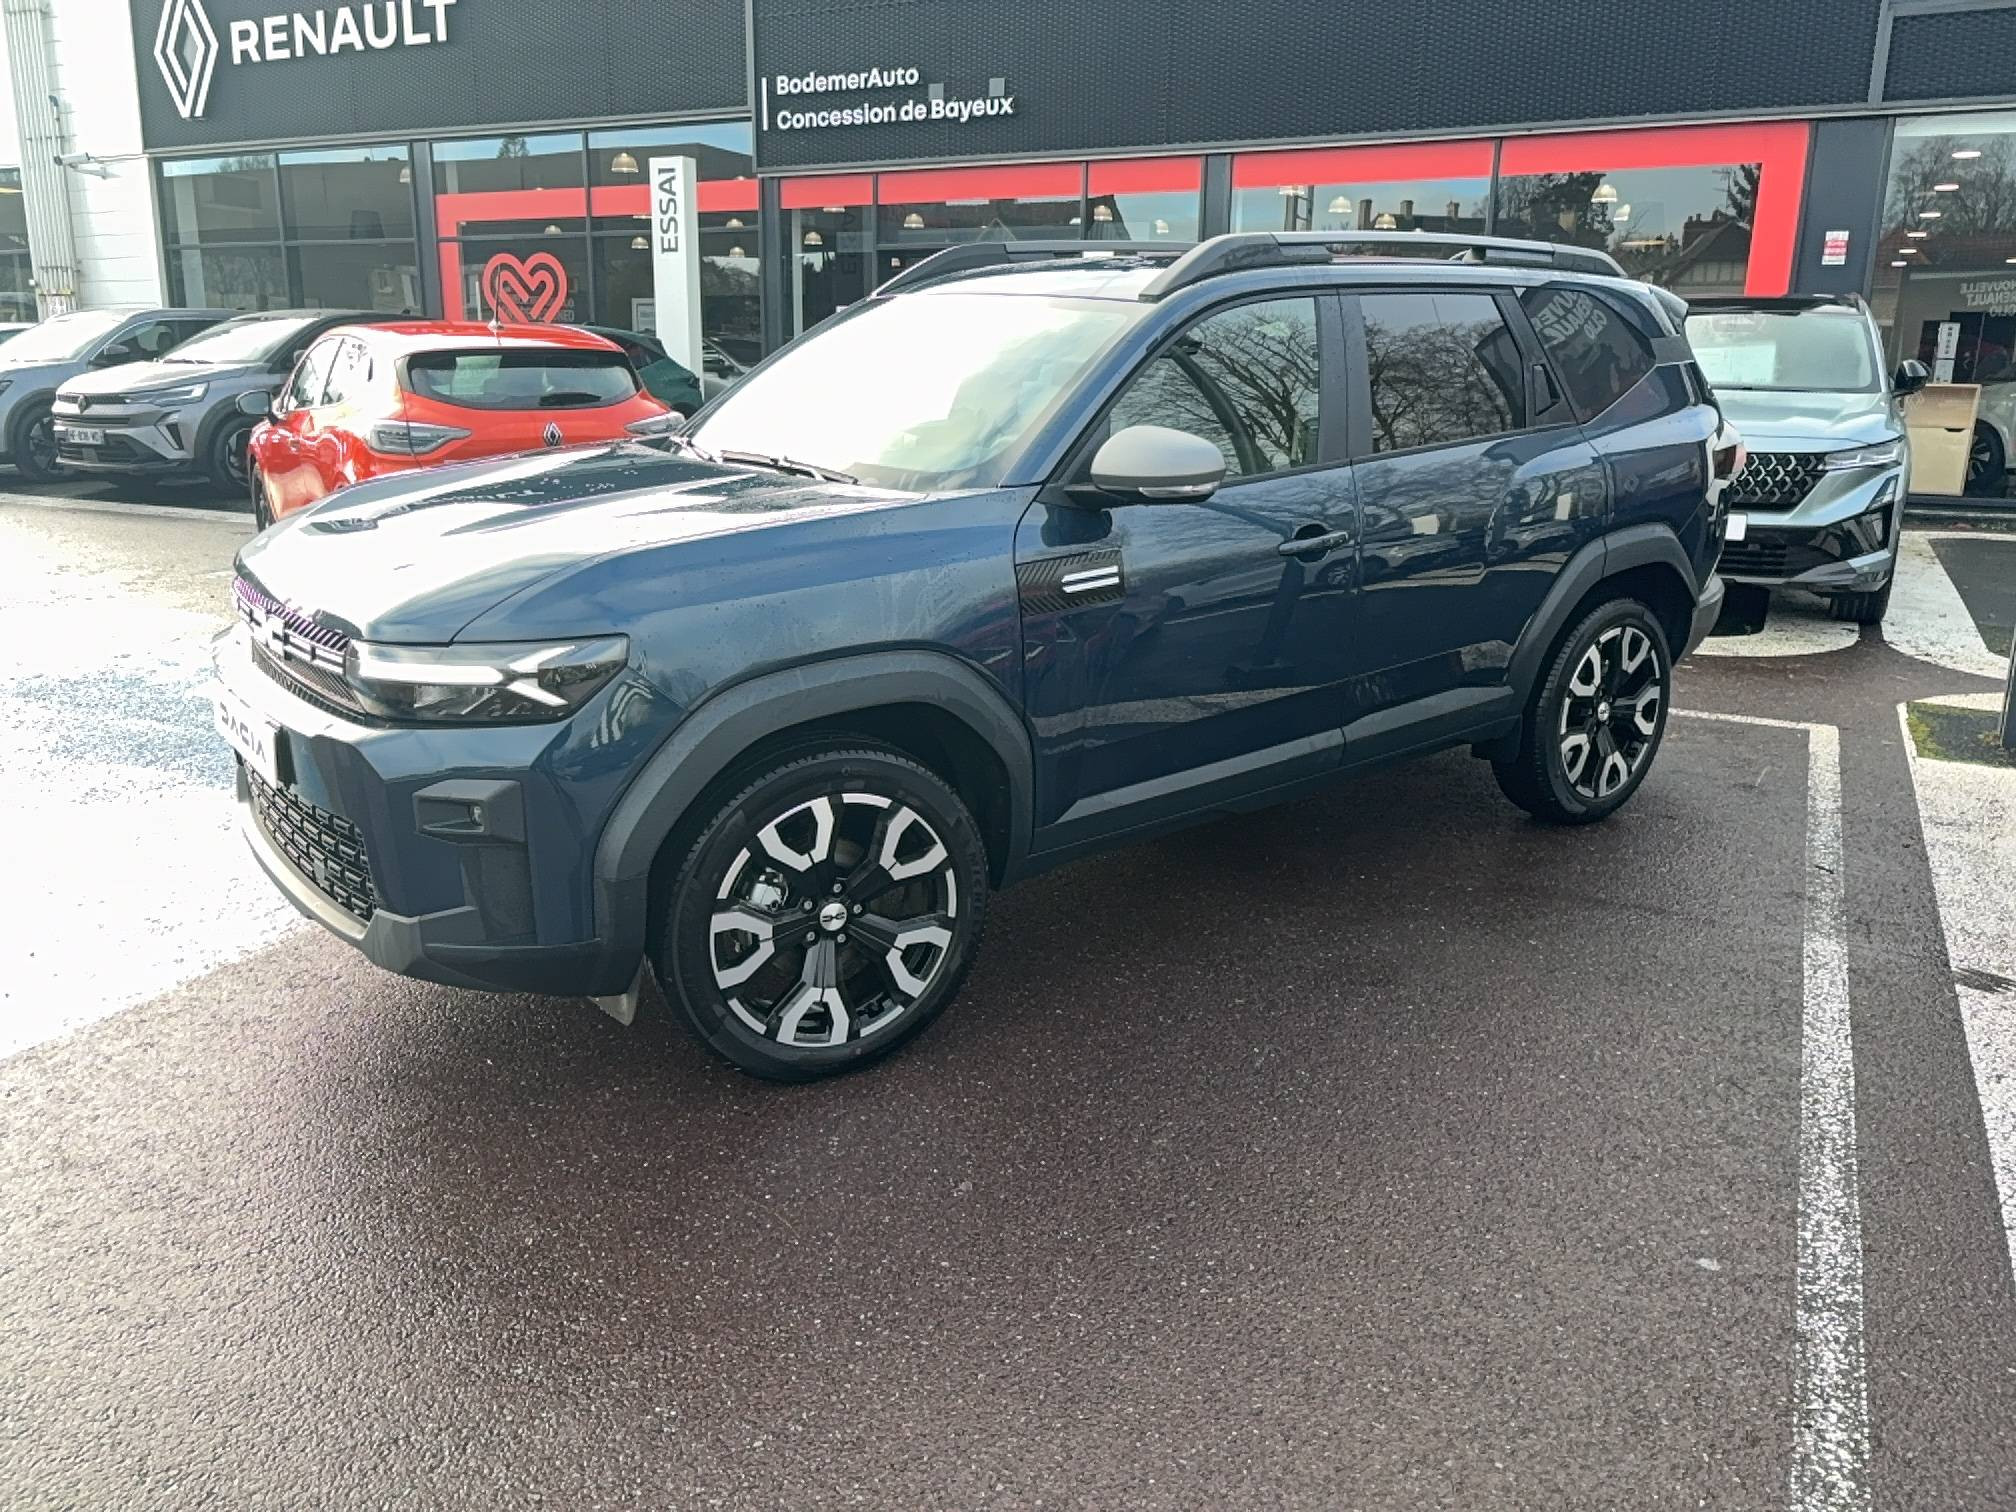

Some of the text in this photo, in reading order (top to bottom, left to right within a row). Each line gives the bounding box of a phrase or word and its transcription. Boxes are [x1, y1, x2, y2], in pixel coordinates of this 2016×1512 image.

[229, 0, 457, 65] RENAULT
[776, 67, 920, 95] BodemerAuto
[776, 96, 1014, 130] Concession de Bayeux
[658, 168, 679, 254] ESSAI
